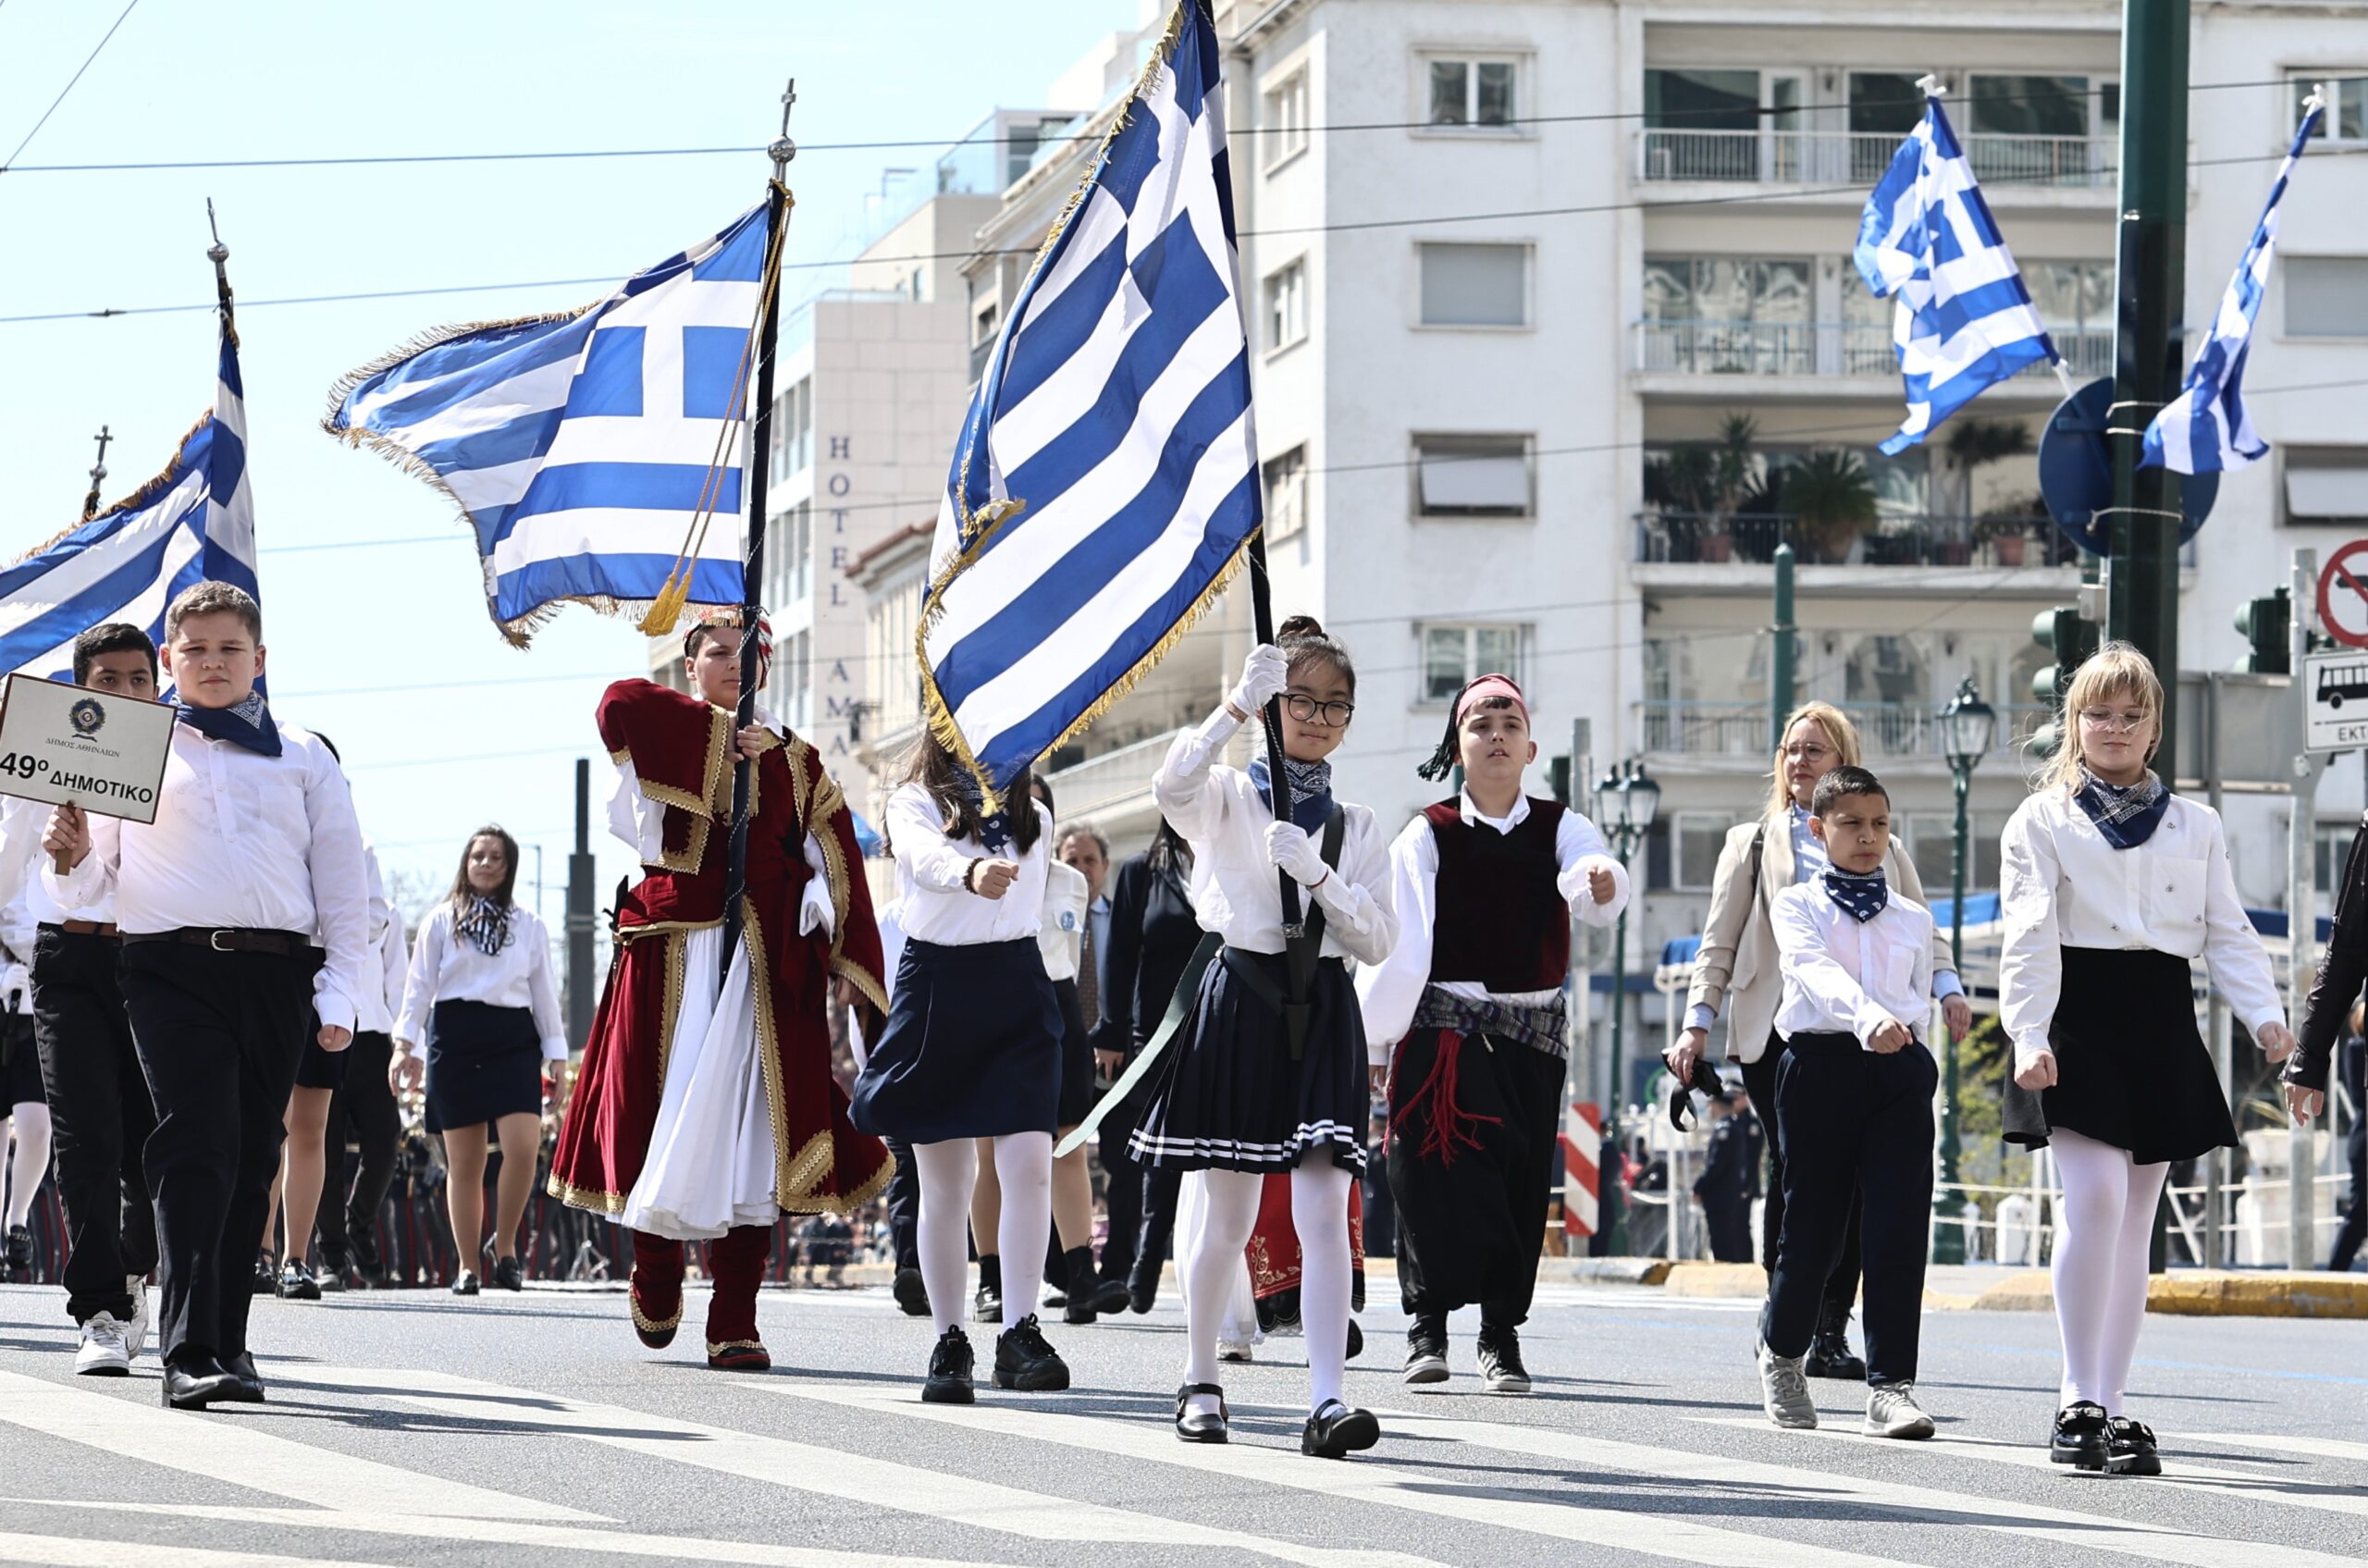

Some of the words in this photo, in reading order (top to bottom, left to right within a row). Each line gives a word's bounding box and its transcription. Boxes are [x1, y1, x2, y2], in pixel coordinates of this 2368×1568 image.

[829, 436, 851, 608] HOTEL
[45, 737, 75, 749] ΔΗΜΟΣ
[76, 744, 120, 758] ΑΘΗΝΑΙΩΝ
[49, 771, 153, 803] ΔΗΜΟΤΙΚΟ
